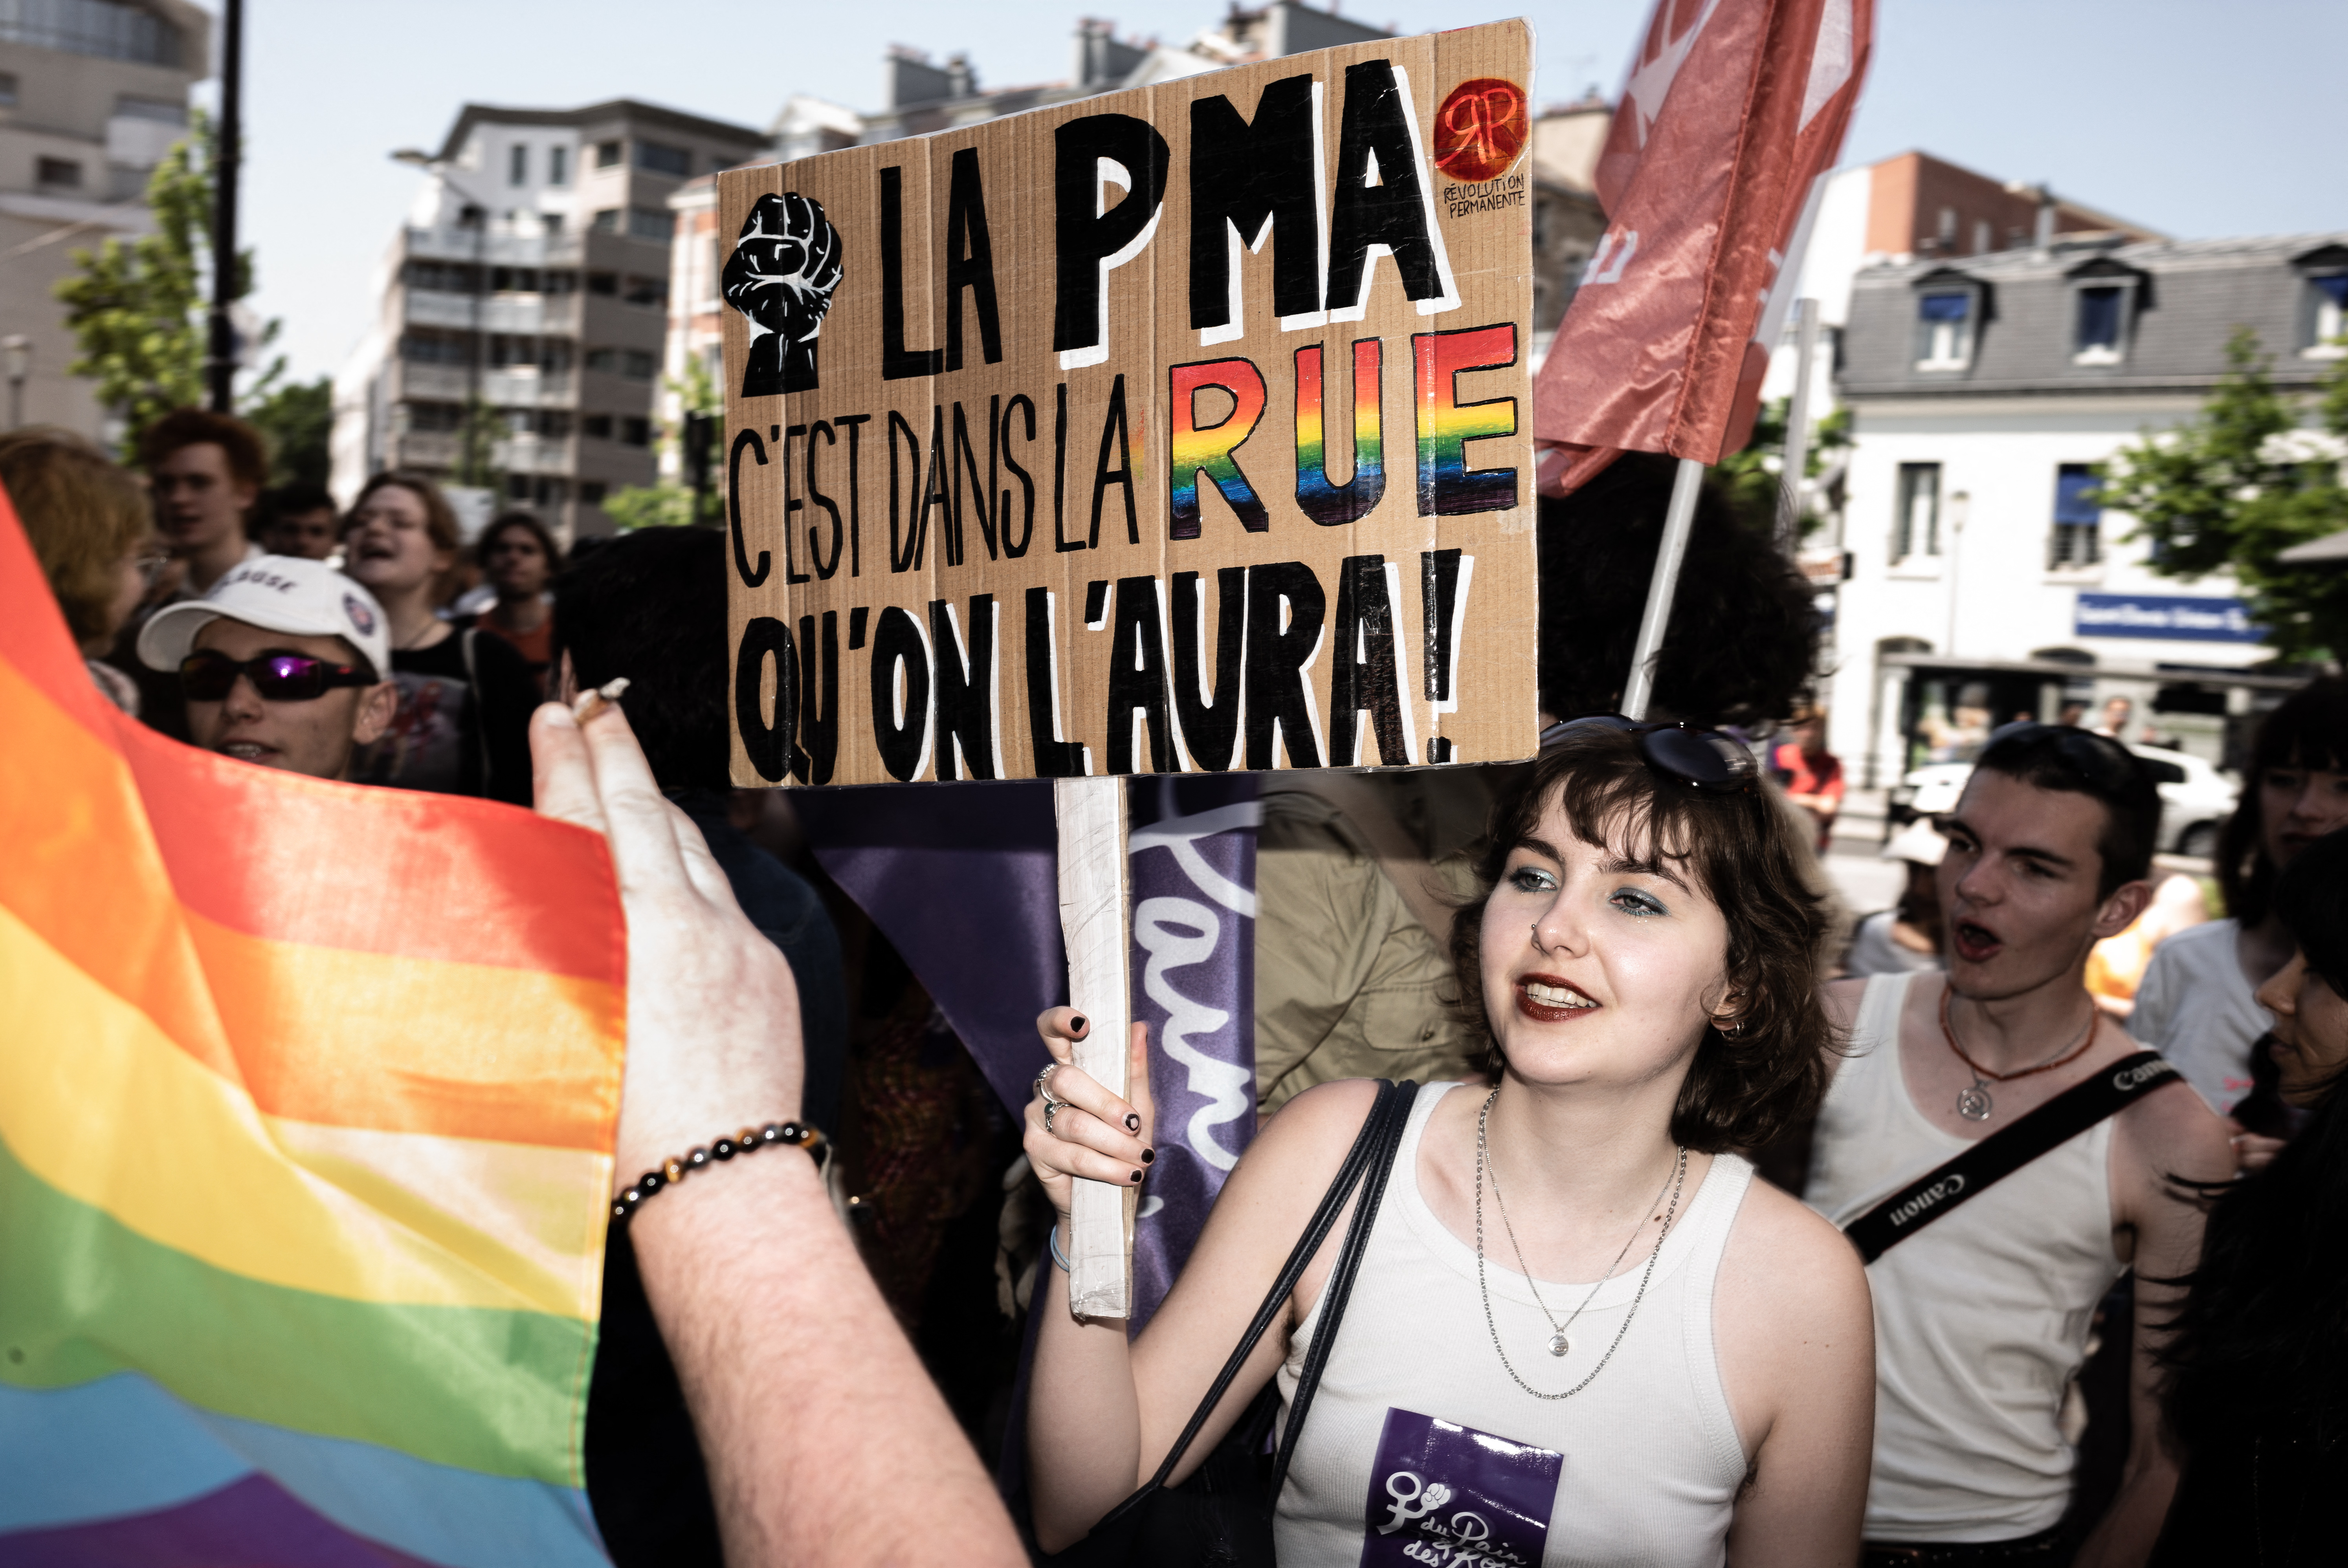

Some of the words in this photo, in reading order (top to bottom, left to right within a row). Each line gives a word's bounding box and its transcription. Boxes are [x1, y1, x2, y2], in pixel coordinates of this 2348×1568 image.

[880, 147, 1003, 382] LA
[1053, 59, 1461, 370] PMA
[1450, 191, 1525, 219] PERMANENTE
[729, 412, 872, 588] C'EST
[887, 392, 1037, 575] DANS
[1053, 373, 1140, 553] LA
[1168, 322, 1518, 540] RUE
[735, 592, 1006, 786] QU'ON
[2113, 1059, 2175, 1091] Can
[1889, 1173, 1966, 1226] Canon
[1403, 1540, 1439, 1568] des
[1420, 1516, 1450, 1537] du
[1451, 1511, 1527, 1565] Pain
